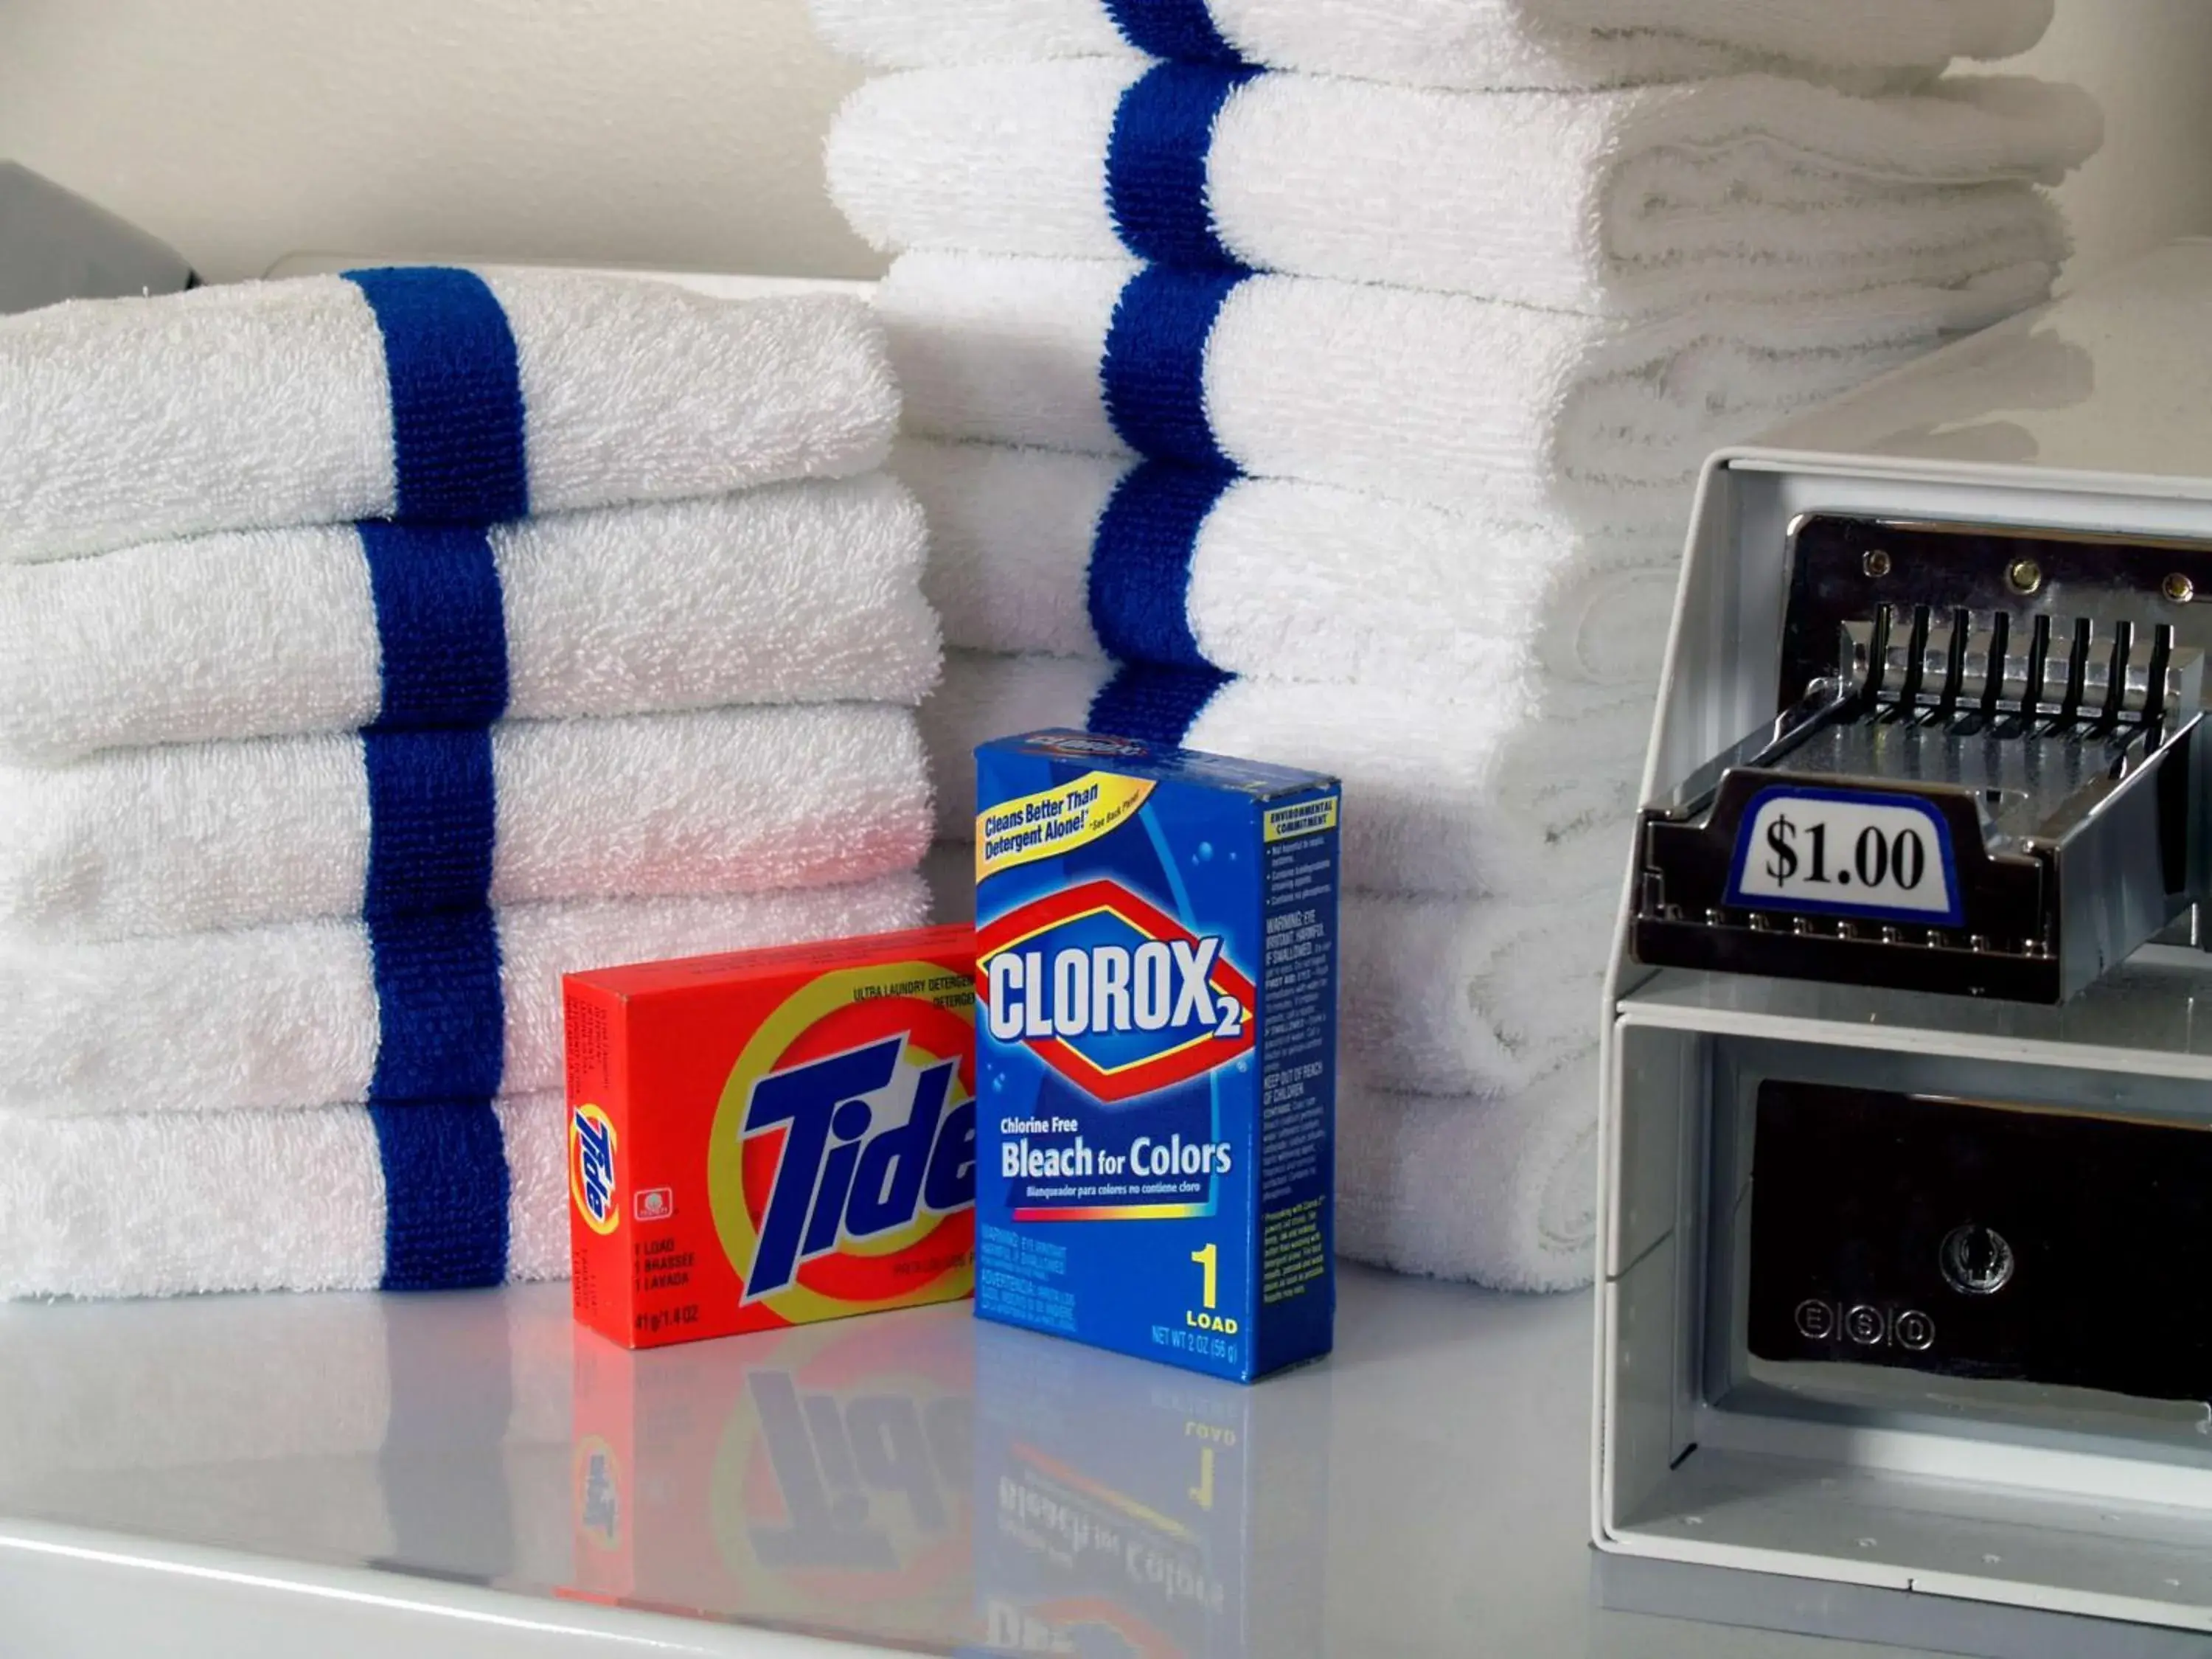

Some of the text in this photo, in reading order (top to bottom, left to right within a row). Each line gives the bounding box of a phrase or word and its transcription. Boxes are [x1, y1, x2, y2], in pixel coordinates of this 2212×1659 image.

[985, 784, 1098, 838] Cleans Better Than
[1270, 801, 1333, 824] ENVIRONMENTAL
[1276, 814, 1327, 835] COMMITMENT
[985, 829, 1042, 860] Detergent
[1766, 813, 1924, 890] $1.00
[853, 984, 883, 1001] ULTRA
[884, 979, 926, 997] LAUNDRY
[1001, 1116, 1077, 1134] Chlorine Free
[574, 1107, 616, 1224] Tide
[1001, 1135, 1093, 1178] Bleach
[1098, 1150, 1126, 1175] for
[1130, 1133, 1232, 1176] Colors
[1026, 1180, 1201, 1199] Blanqueador para colores no contiene cloro
[1191, 1242, 1217, 1309] 1
[1186, 1310, 1238, 1334] LOAD
[1152, 1325, 1170, 1345] NET
[1172, 1329, 1186, 1349] WT
[1188, 1334, 1194, 1352] 2
[1197, 1335, 1209, 1354] OZ
